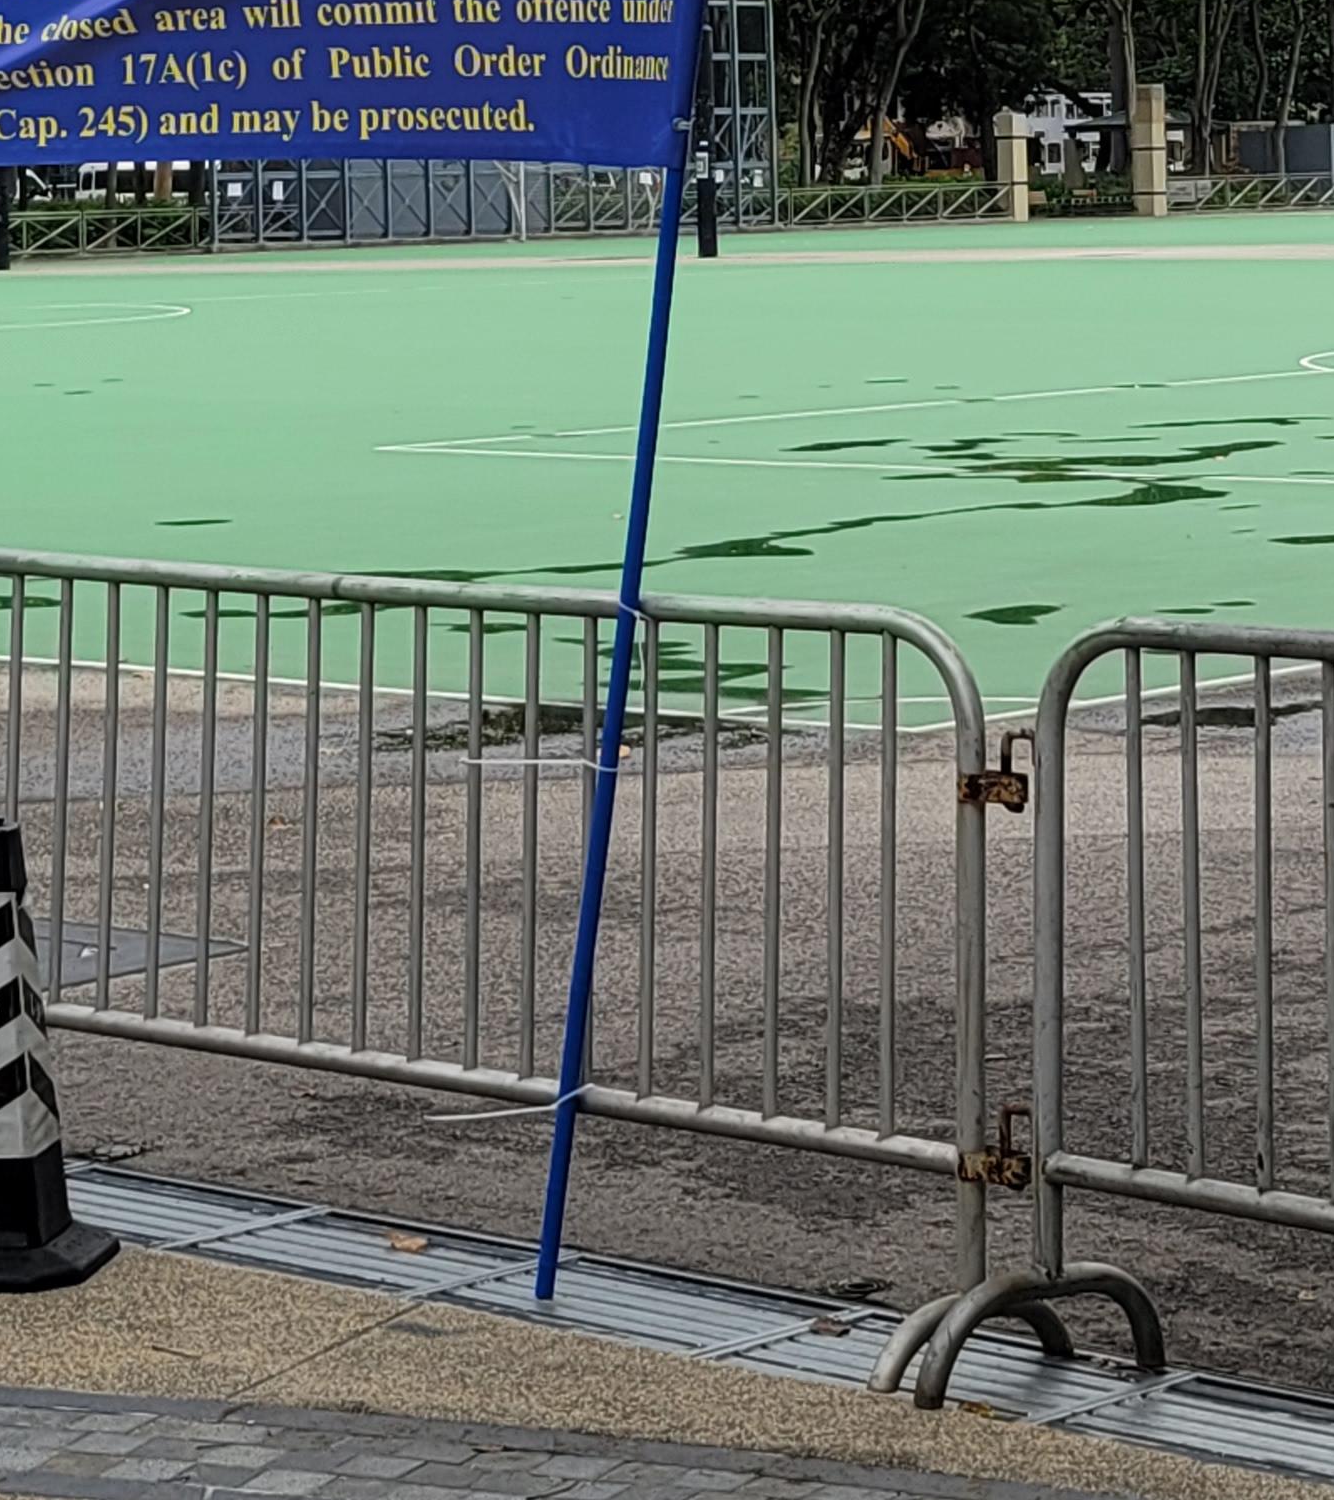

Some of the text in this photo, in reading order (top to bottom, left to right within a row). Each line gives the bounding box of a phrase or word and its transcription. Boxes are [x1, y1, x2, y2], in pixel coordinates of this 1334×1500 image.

[41, 8, 139, 42] closed
[153, 5, 227, 33] area
[122, 52, 249, 88] 17A(1c)
[270, 47, 306, 80] of
[329, 44, 431, 80] Public
[453, 43, 546, 78] Order
[79, 104, 150, 139] 245)
[158, 102, 220, 136] and
[230, 107, 301, 142] may
[310, 99, 350, 133] be
[358, 99, 535, 140] prosecuted.
